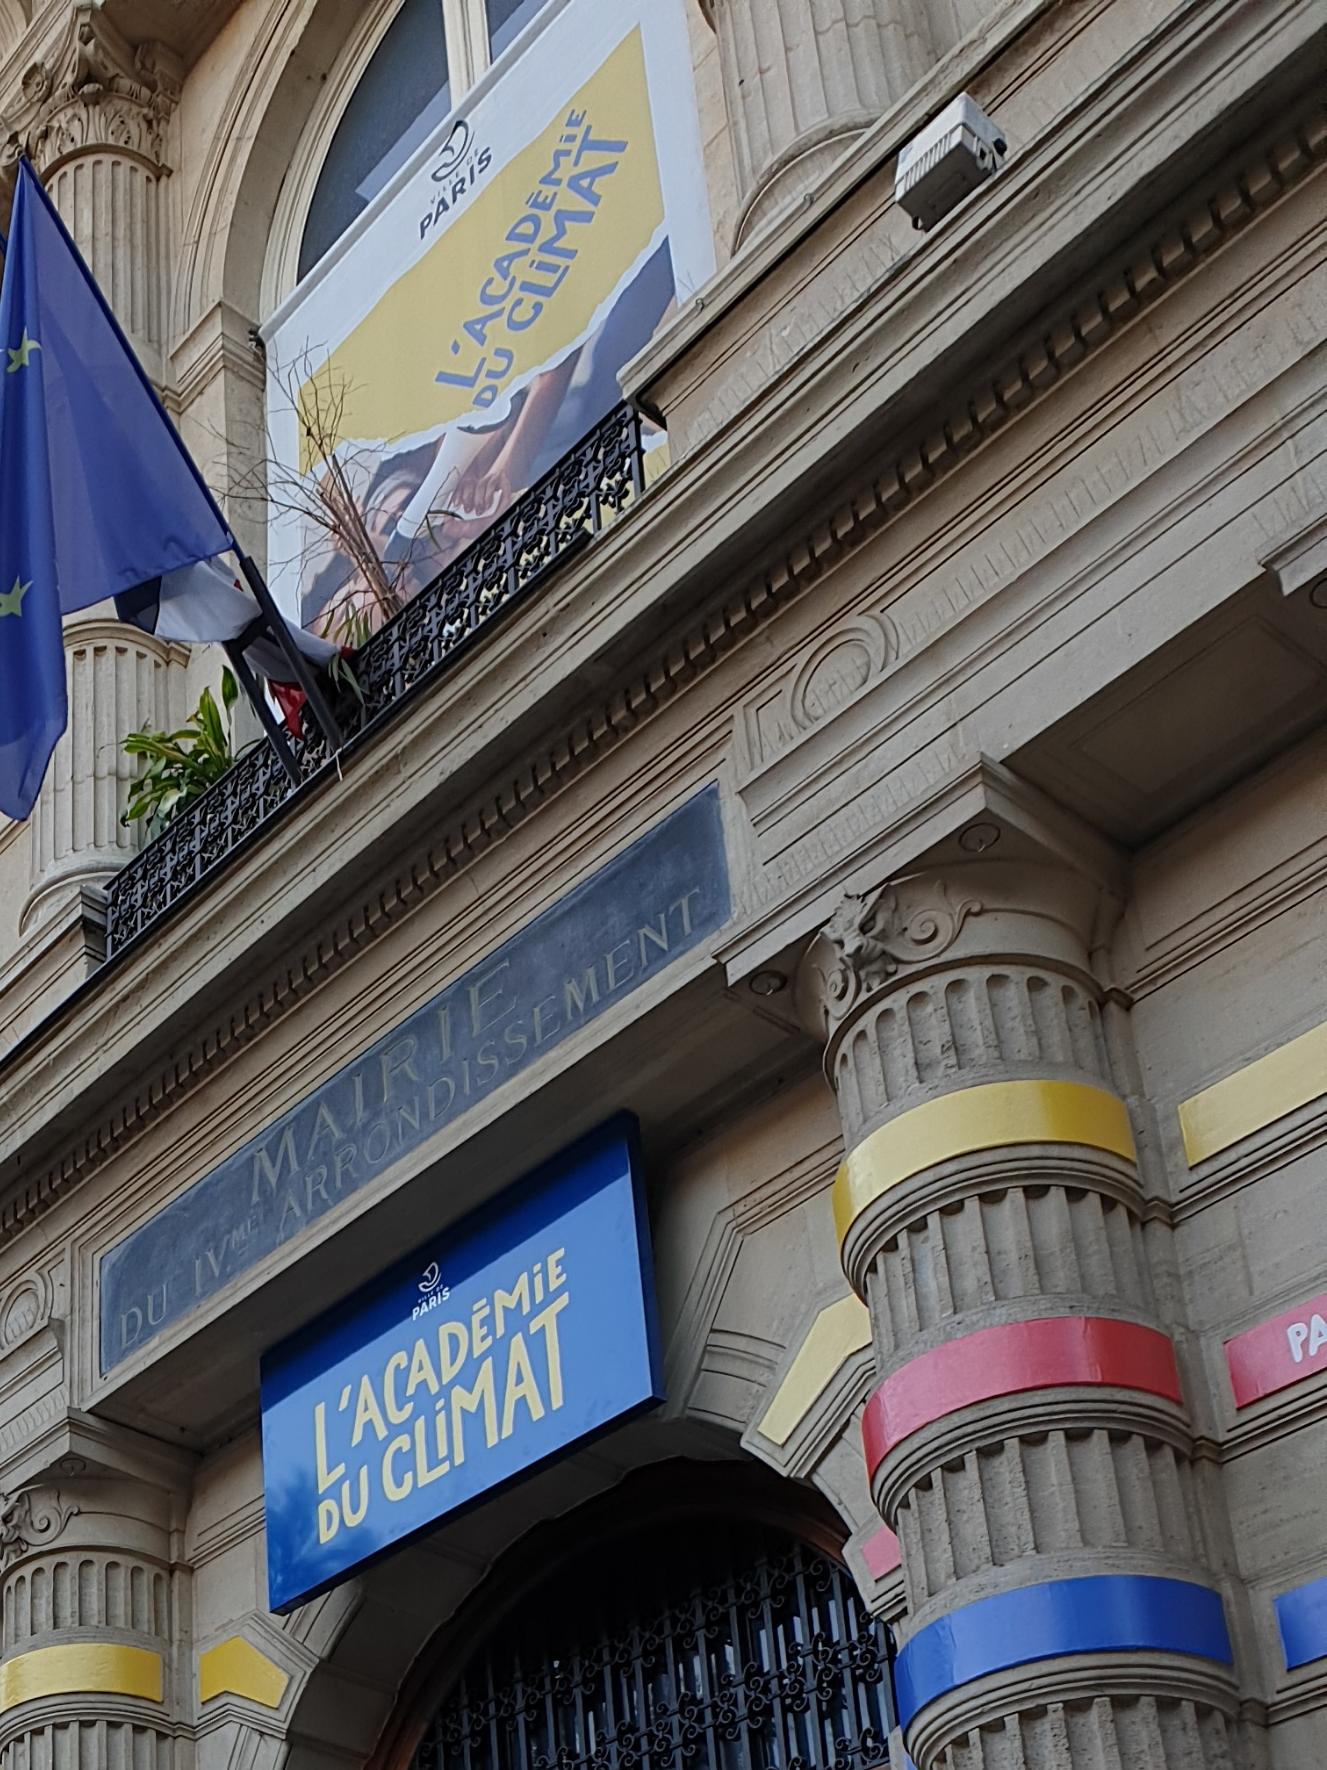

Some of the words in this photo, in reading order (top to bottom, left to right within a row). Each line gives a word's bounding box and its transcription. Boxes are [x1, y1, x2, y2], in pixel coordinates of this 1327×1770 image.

[419, 146, 493, 241] PARIS
[472, 348, 515, 411] DU
[120, 1280, 169, 1350] DU
[278, 886, 702, 1242] ARRONDISSEMENT
[250, 961, 519, 1206] MAIRIE
[412, 1286, 451, 1321] PARIS
[317, 1464, 371, 1546] DU
